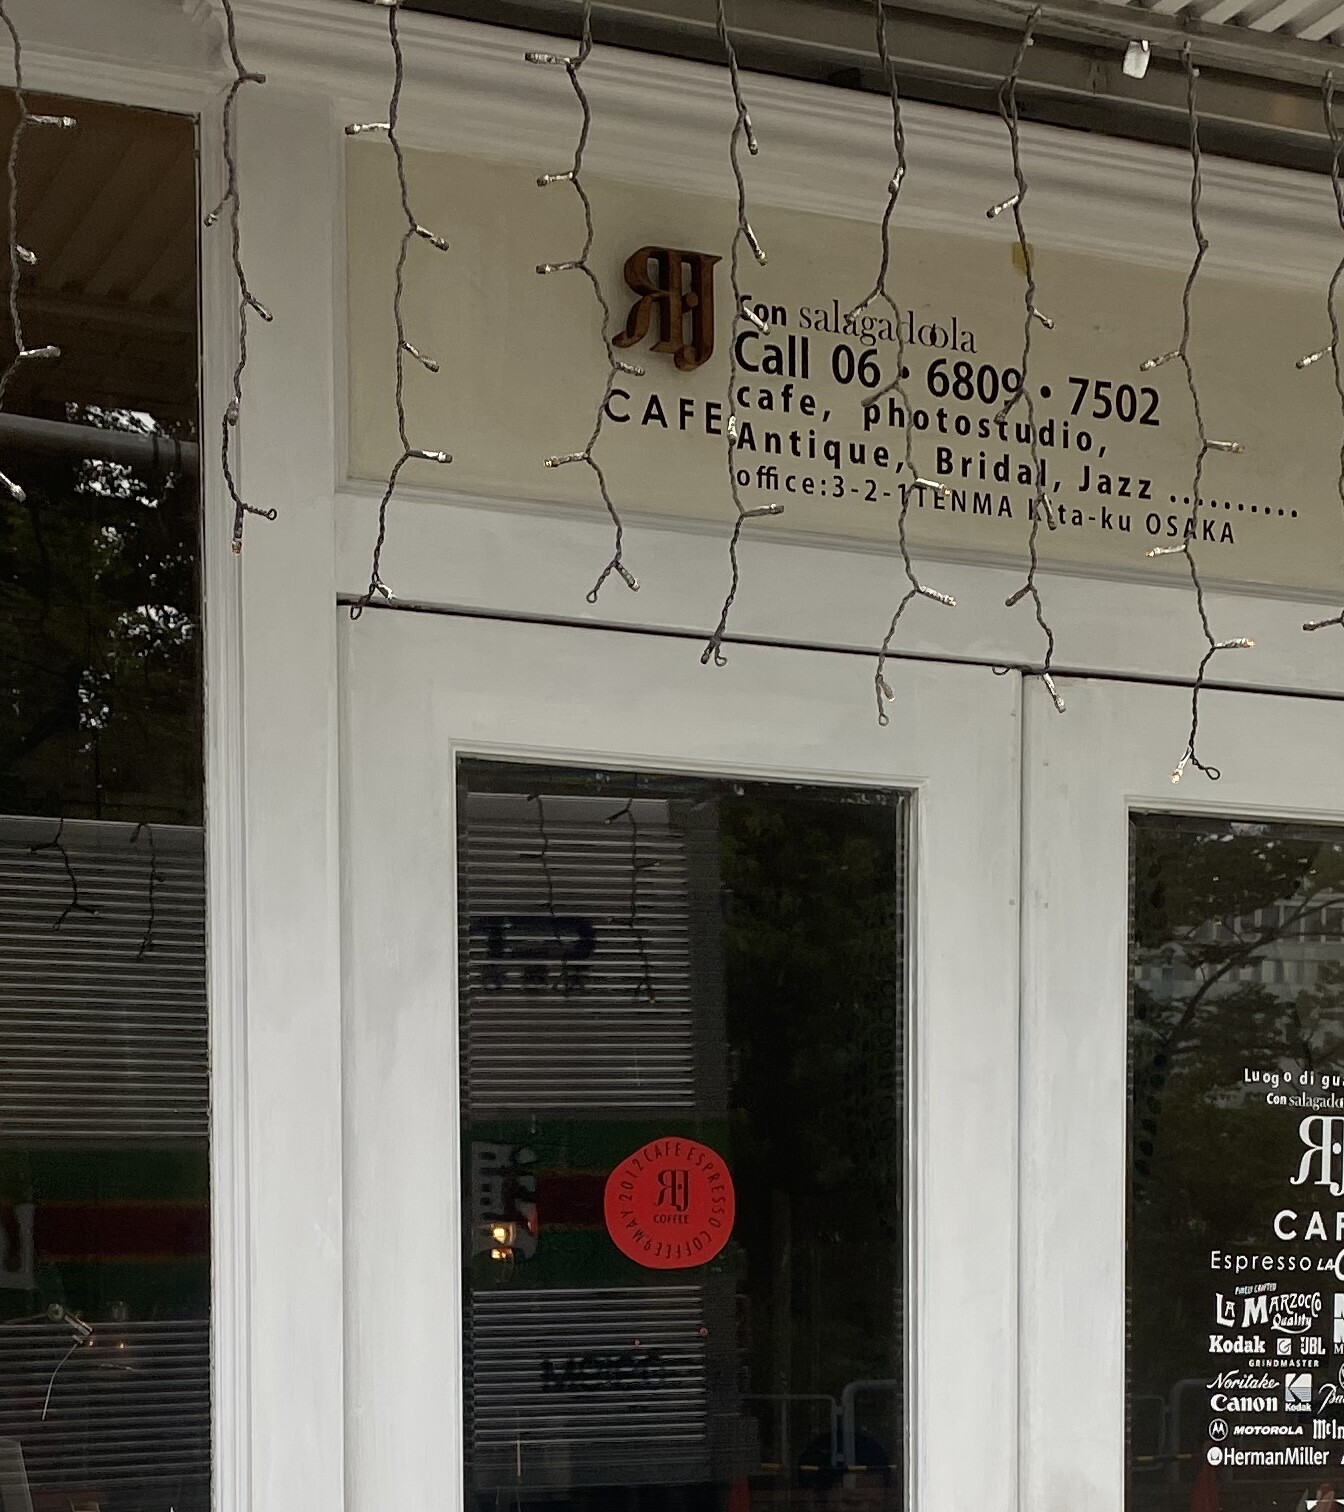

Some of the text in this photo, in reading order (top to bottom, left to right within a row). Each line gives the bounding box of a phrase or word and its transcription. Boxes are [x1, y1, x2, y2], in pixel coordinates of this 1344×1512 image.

[734, 331, 809, 379] Call
[832, 344, 881, 388] 06
[1068, 376, 1160, 426] 7502
[605, 389, 722, 436] CAFE
[737, 384, 1107, 458] cafe, photostudio,
[737, 421, 1153, 501] Antique, Bridal, Jazz
[1145, 511, 1236, 545] OSAKA
[1244, 1068, 1292, 1088] Luogo
[1300, 1071, 1314, 1085] di
[1267, 1093, 1286, 1105] Con
[1211, 1251, 1312, 1273] Espresso
[1209, 1335, 1266, 1353] Kodak
[1206, 1369, 1280, 1389] Noritake
[1210, 1394, 1278, 1412] Canon
[1233, 1426, 1303, 1435] MOTOROLA
